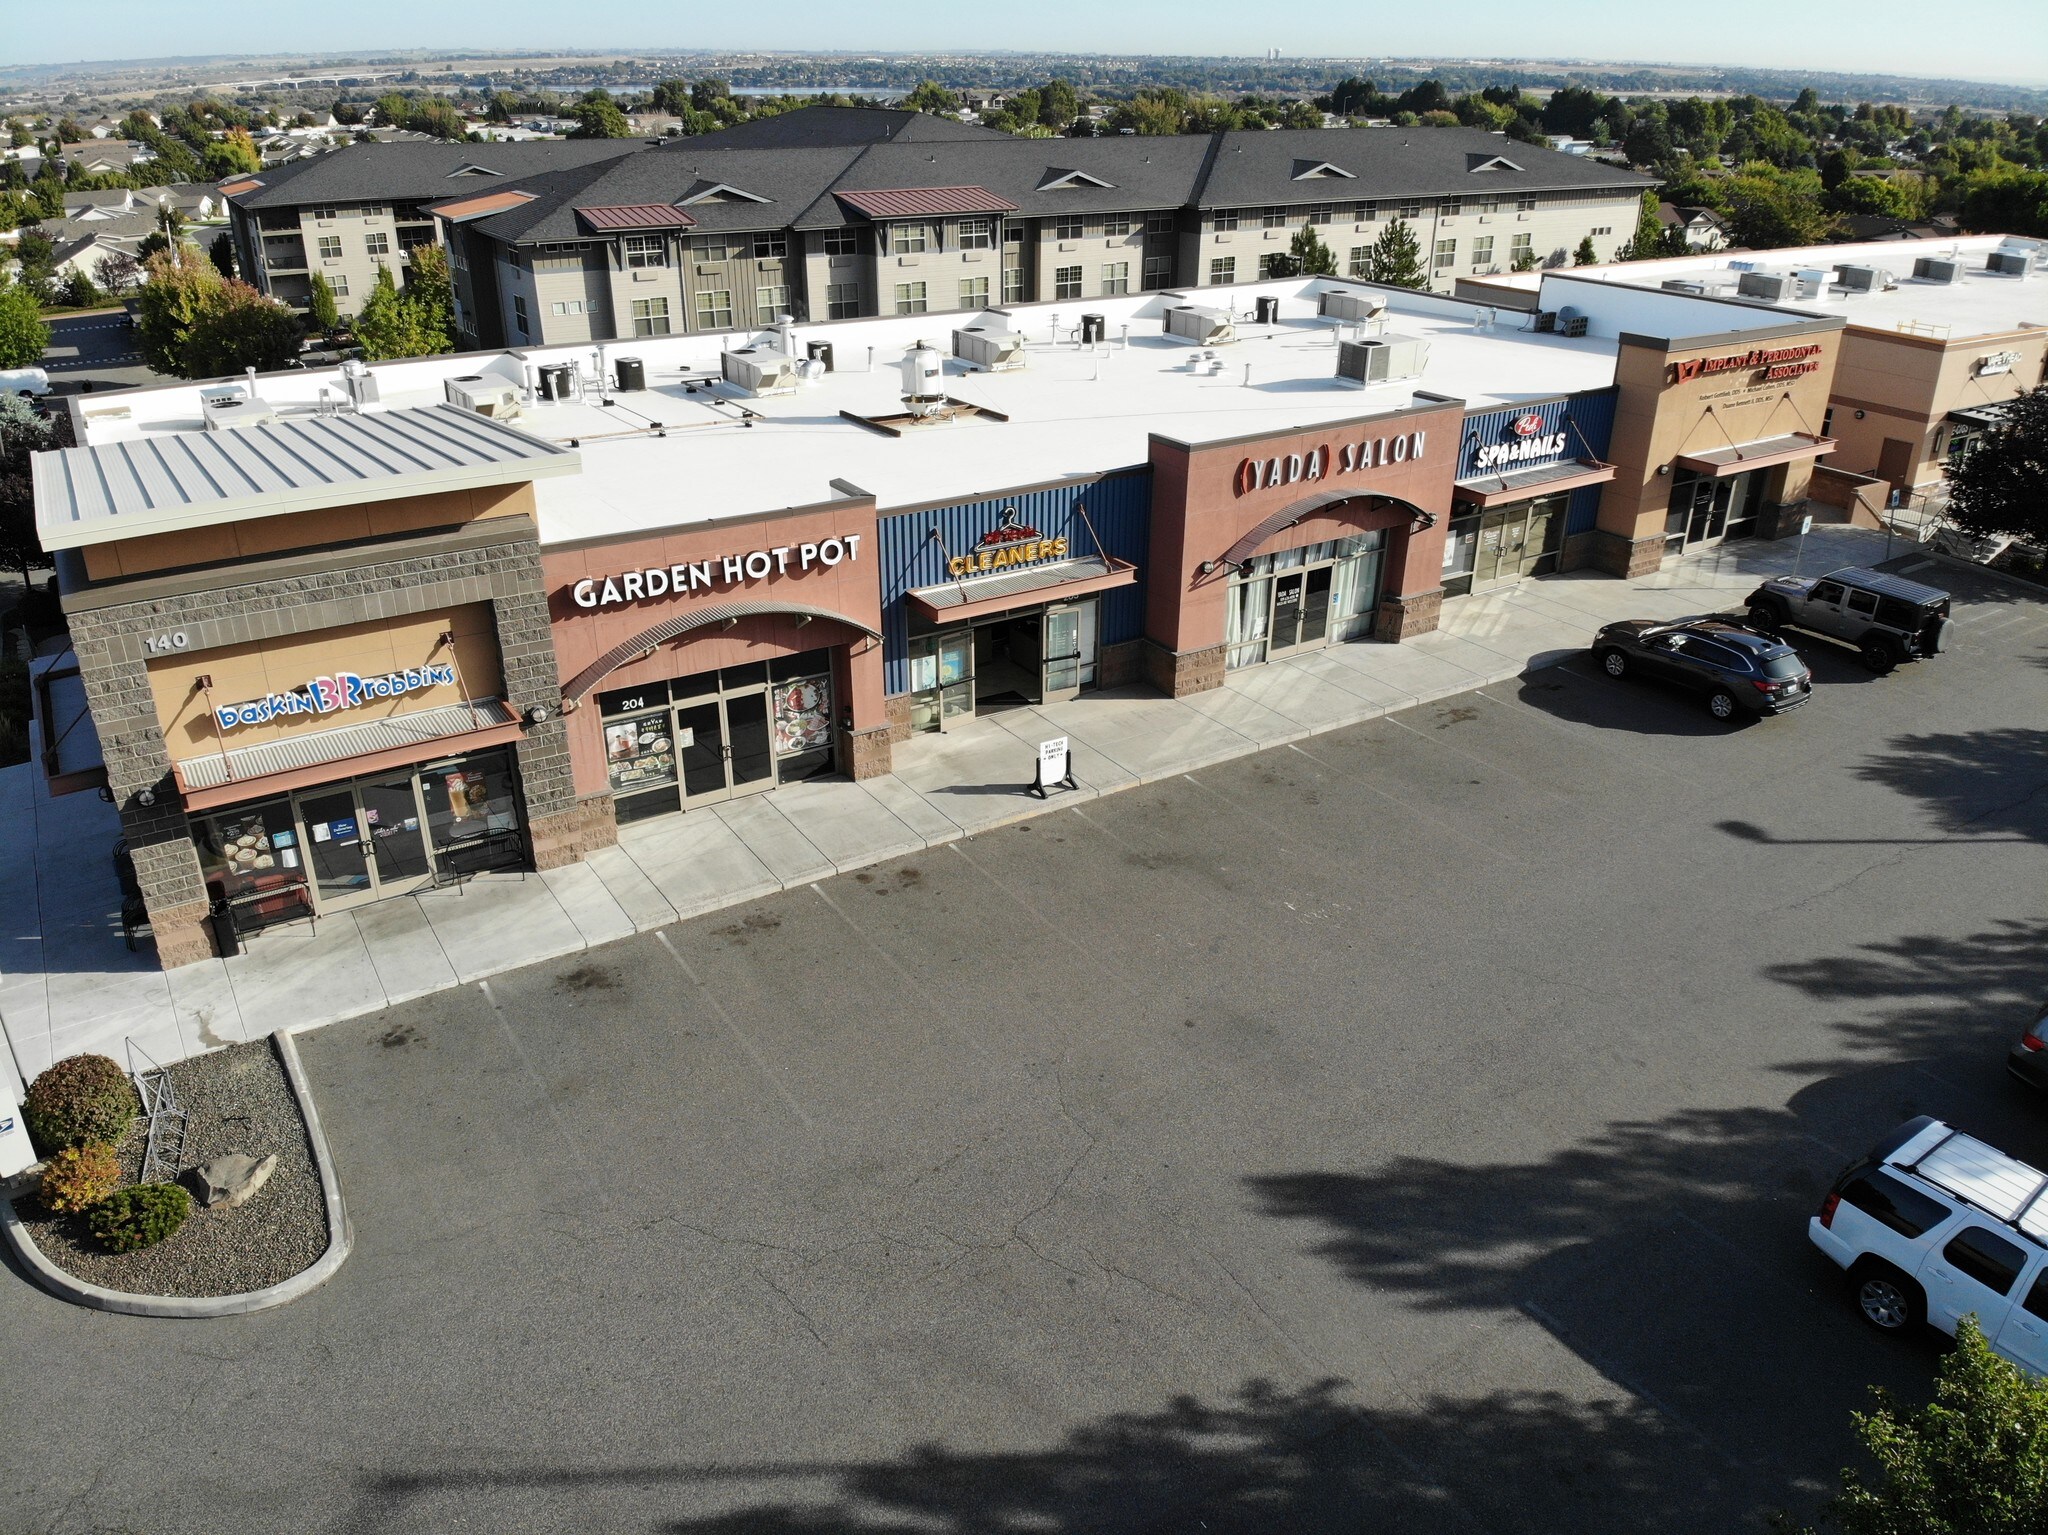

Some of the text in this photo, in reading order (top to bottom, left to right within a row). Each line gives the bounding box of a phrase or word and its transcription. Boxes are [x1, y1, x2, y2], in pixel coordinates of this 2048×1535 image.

[1703, 345, 1822, 372] IMPLANT & PERIODONTAL
[1766, 361, 1819, 379] ASSOCIATES
[1345, 431, 1426, 472] SALON
[950, 537, 1069, 575] CLEANERS
[573, 534, 861, 608] GARDEN HOT POT
[146, 632, 188, 653] 140
[216, 664, 455, 730] baskin BR robbins
[622, 697, 645, 711] 204
[1045, 741, 1064, 749] HI-TECH
[1045, 747, 1063, 755] PARKING
